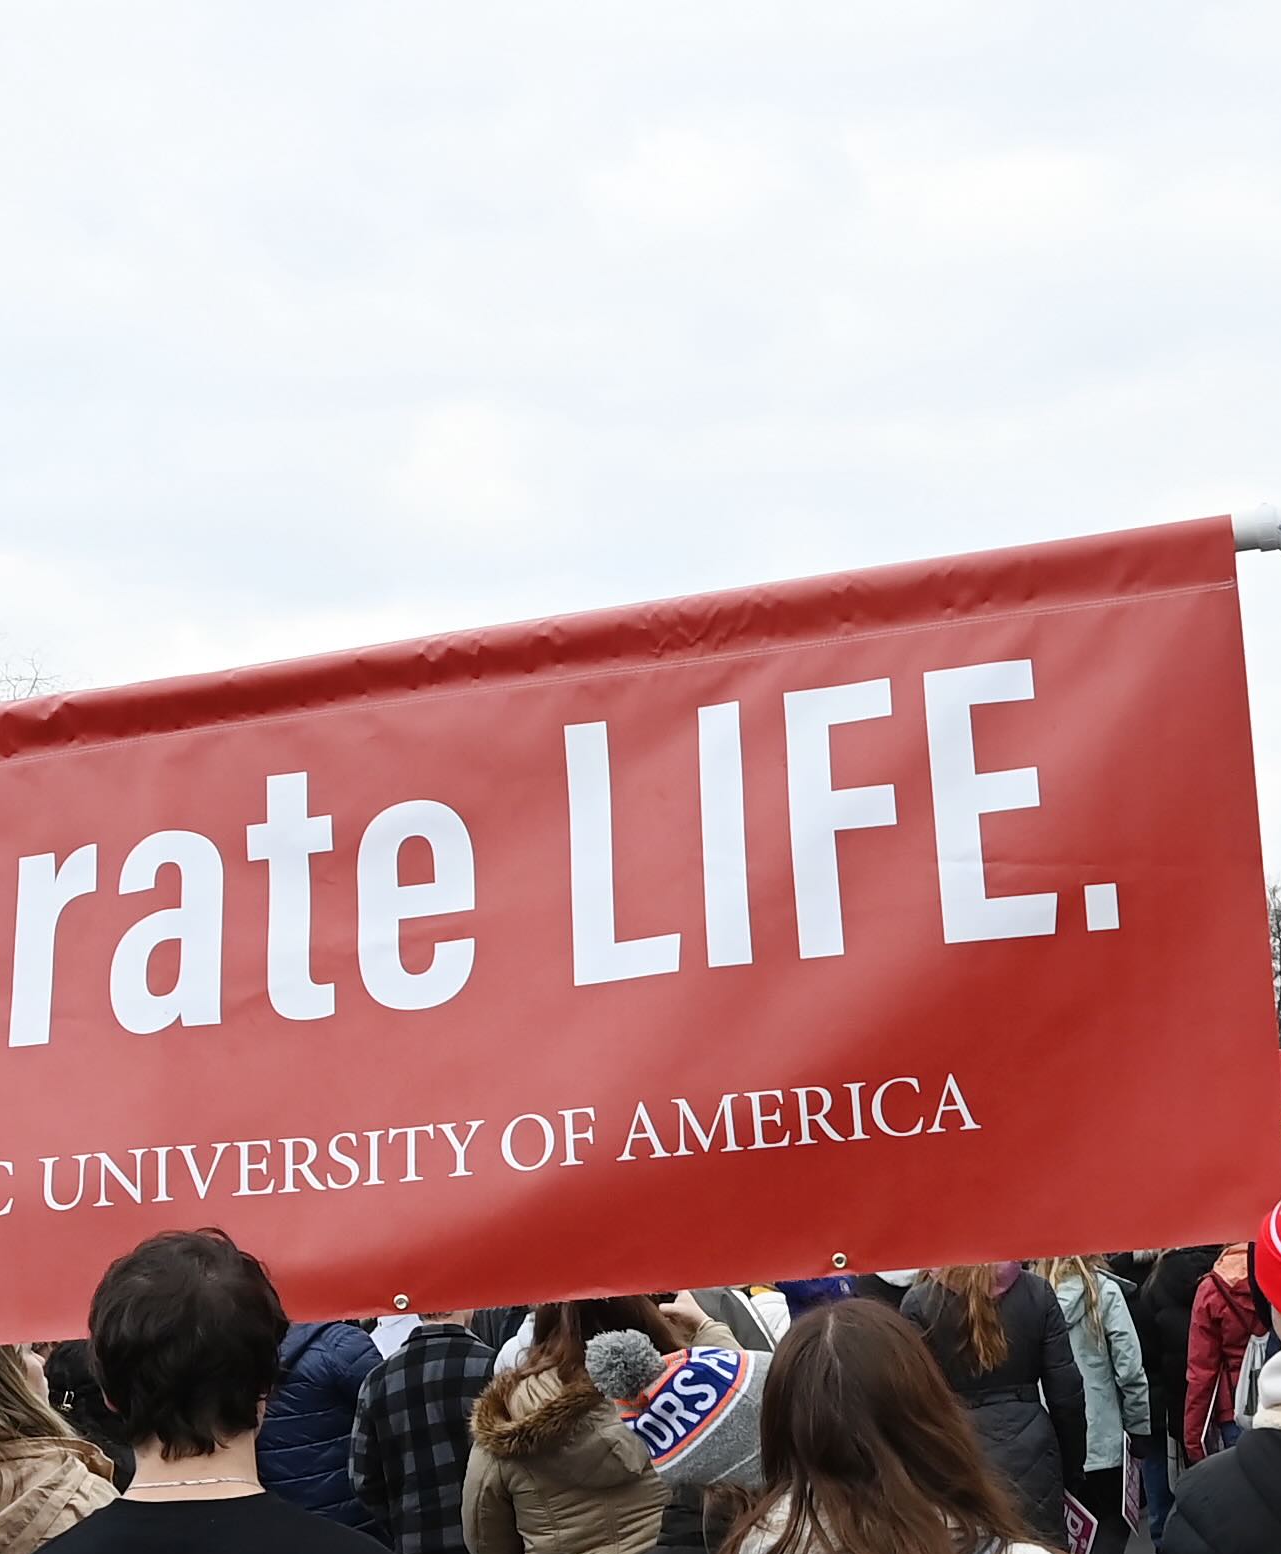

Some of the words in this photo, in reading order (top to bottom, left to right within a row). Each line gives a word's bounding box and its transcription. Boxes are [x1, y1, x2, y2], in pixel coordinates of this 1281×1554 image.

[563, 658, 1120, 987] LIFE.
[38, 1119, 485, 1210] UNIVERSITY
[500, 1106, 596, 1172] OF
[616, 1073, 981, 1161] AMERICA
